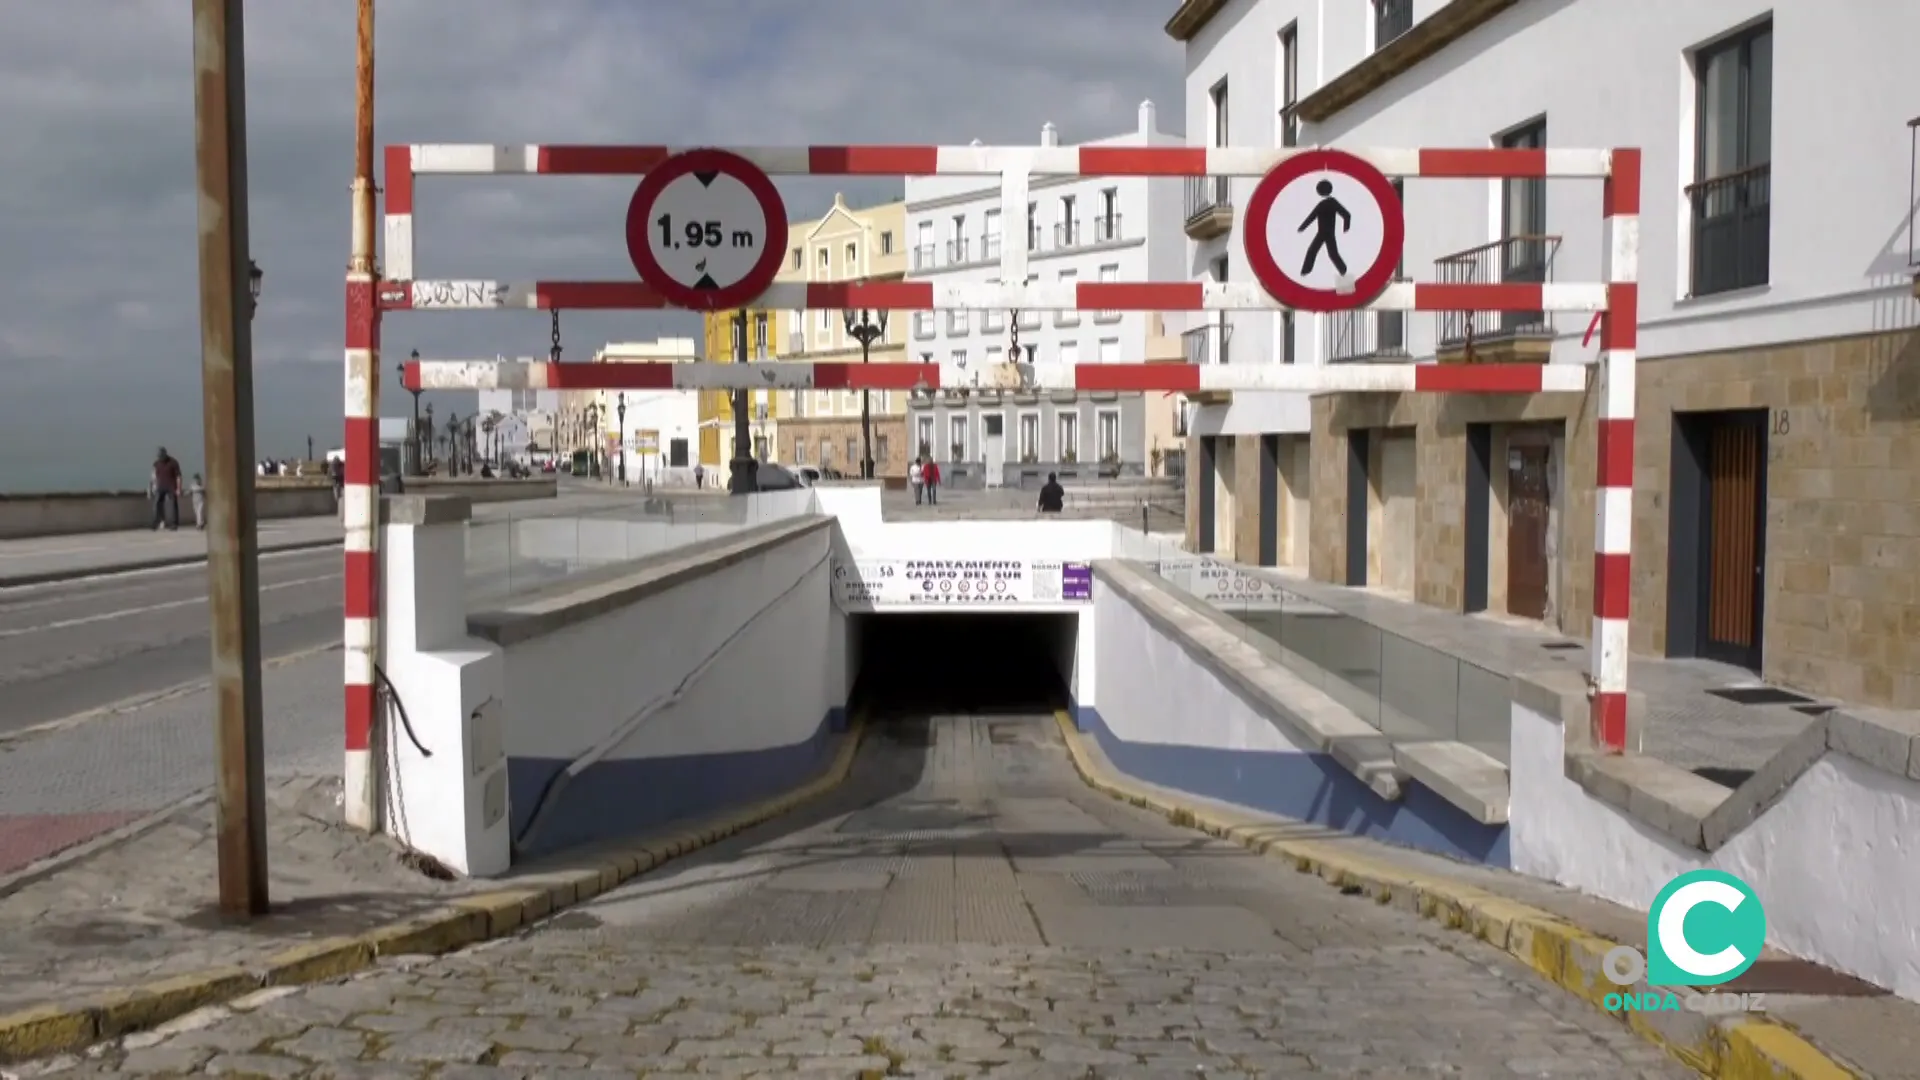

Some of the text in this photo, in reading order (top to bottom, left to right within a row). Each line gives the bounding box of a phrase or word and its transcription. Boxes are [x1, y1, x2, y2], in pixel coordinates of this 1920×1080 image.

[732, 230, 753, 248] m
[1773, 410, 1790, 436] 18
[906, 571, 1021, 579] CAMPO DEL SUR
